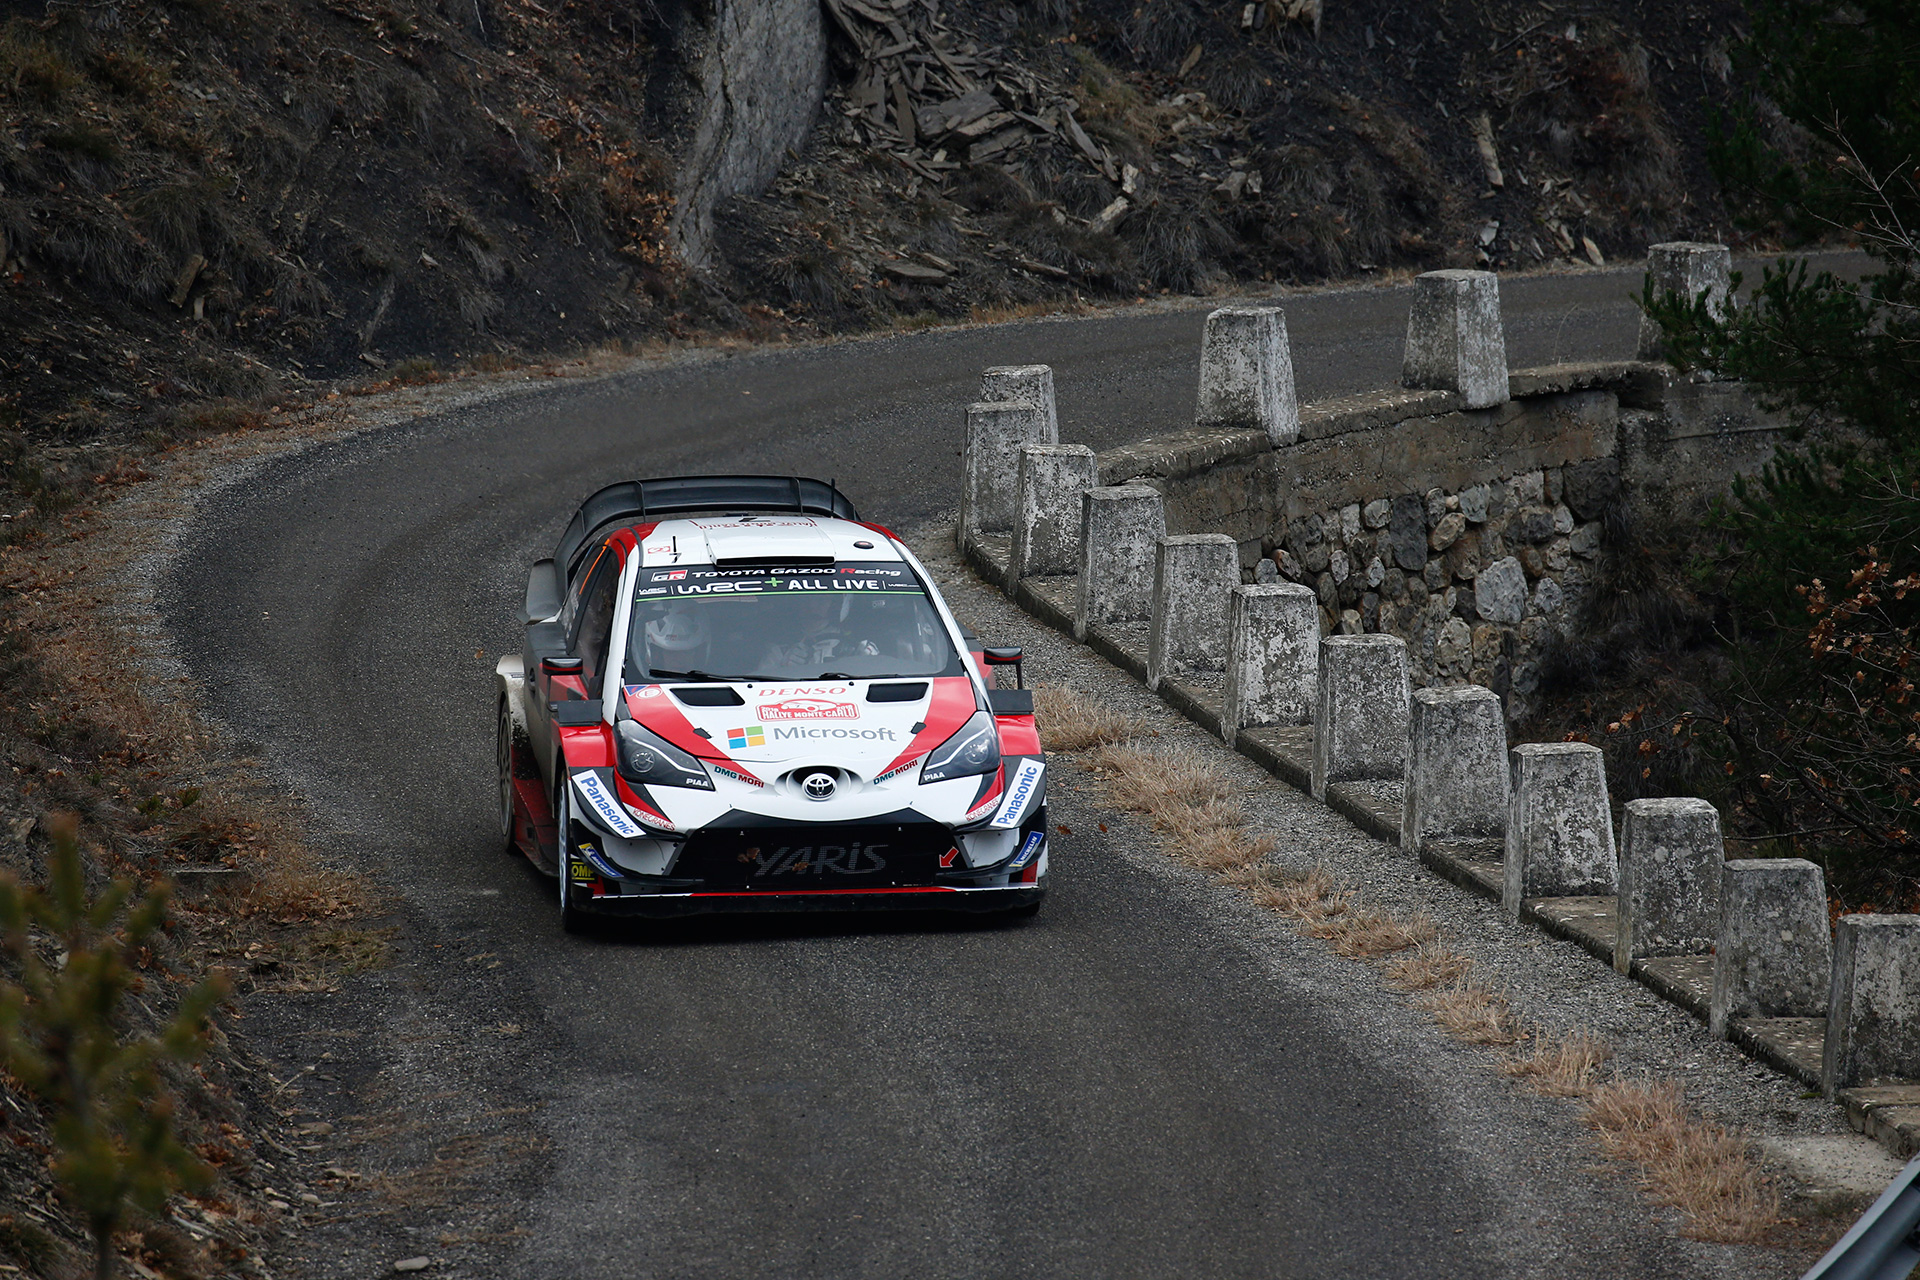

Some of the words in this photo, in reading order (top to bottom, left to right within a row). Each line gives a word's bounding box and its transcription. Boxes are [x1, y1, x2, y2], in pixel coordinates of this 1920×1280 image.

[669, 552, 682, 564] 7
[652, 572, 687, 581] GR
[692, 569, 765, 578] TOYOTA
[770, 567, 836, 575] GAZOO
[840, 568, 901, 577] Racing
[788, 579, 828, 590] ALL
[833, 579, 879, 590] LIVE
[758, 686, 847, 697] DENSO
[762, 709, 792, 719] RALLYE
[794, 707, 855, 718] MONTE-CARLO
[773, 726, 897, 742] Microsoft
[714, 766, 737, 779] DMG
[738, 774, 765, 788] MORI
[873, 771, 895, 785] DMG
[895, 759, 918, 775] MORI
[923, 771, 946, 781] PIAA
[685, 778, 709, 787] PIAA
[996, 765, 1038, 825] Panasonic
[580, 776, 635, 835] Panasonic
[632, 808, 676, 831] KONECRANES
[1020, 835, 1038, 861] MICHELIN
